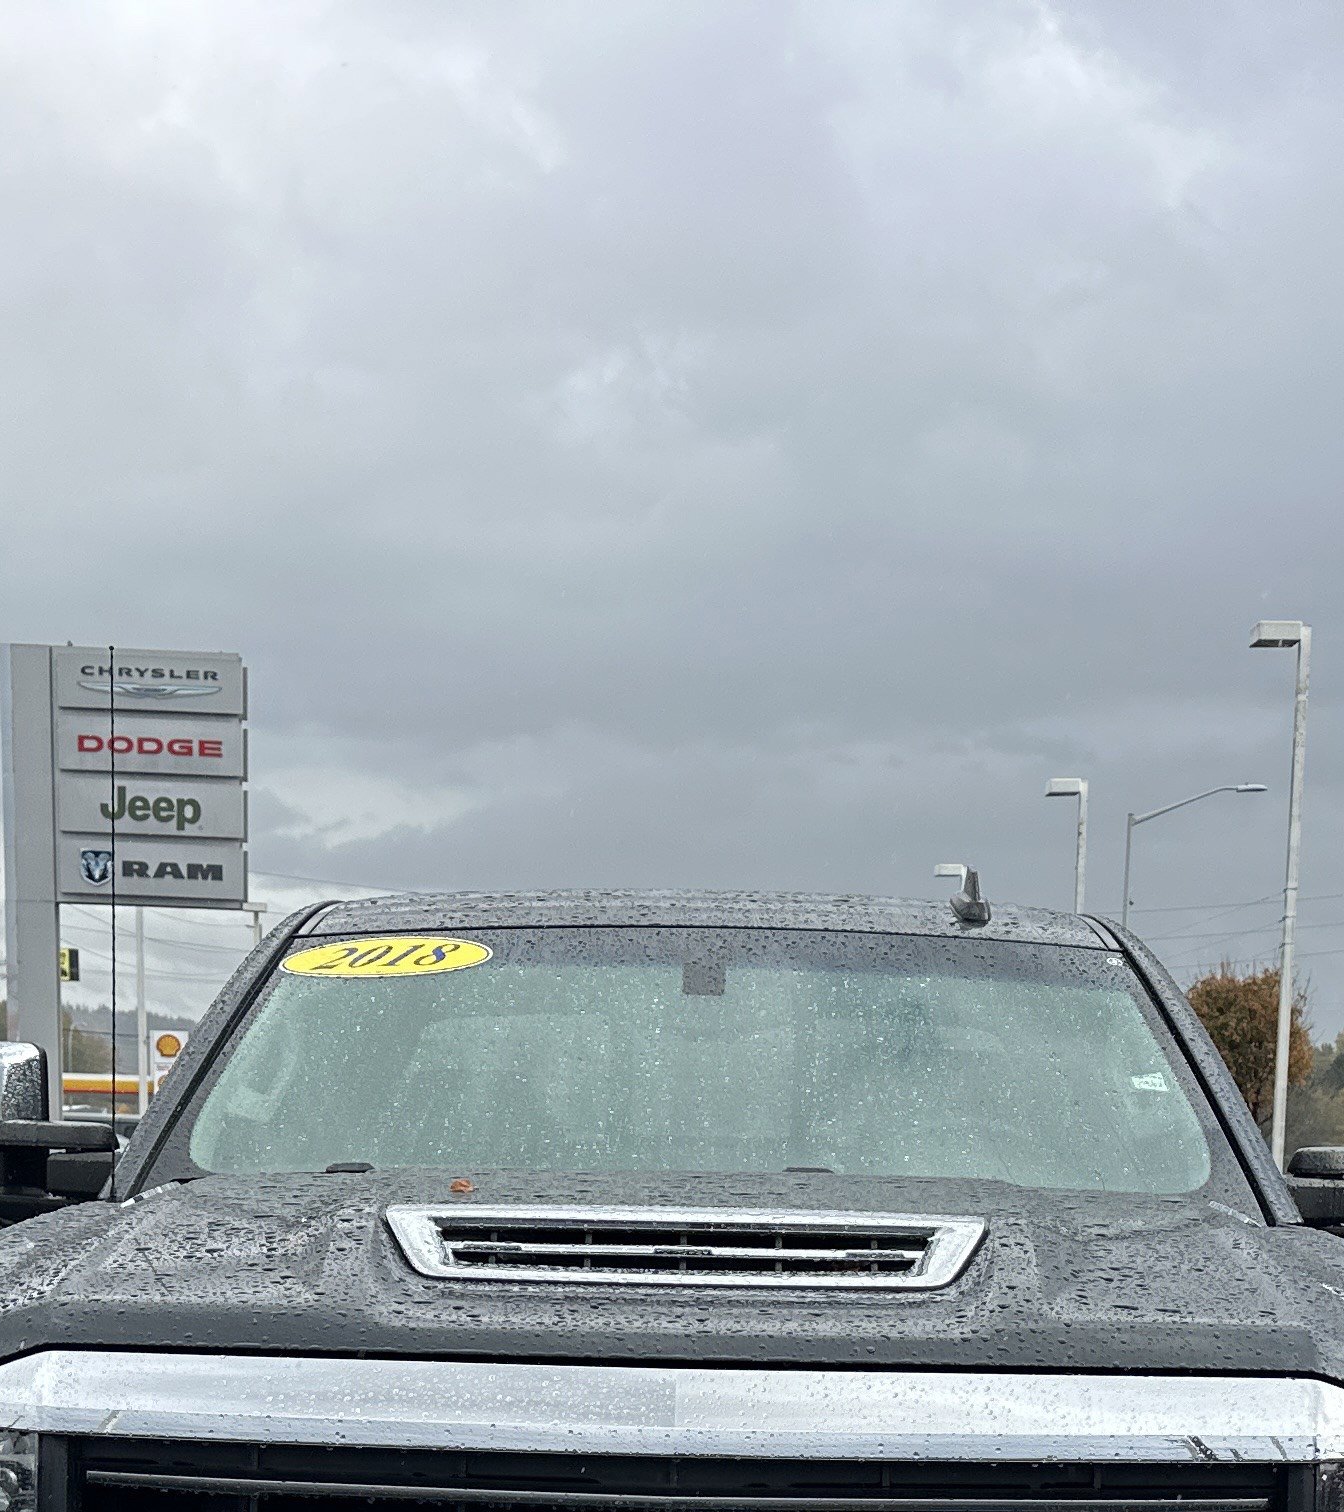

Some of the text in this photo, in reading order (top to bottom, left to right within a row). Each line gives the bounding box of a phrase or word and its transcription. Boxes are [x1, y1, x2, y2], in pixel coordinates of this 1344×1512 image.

[80, 665, 219, 681] CHRYSLER
[77, 734, 223, 758] DODGE
[100, 786, 202, 831] Jeep
[122, 860, 223, 881] RAM
[309, 943, 461, 971] 2018
